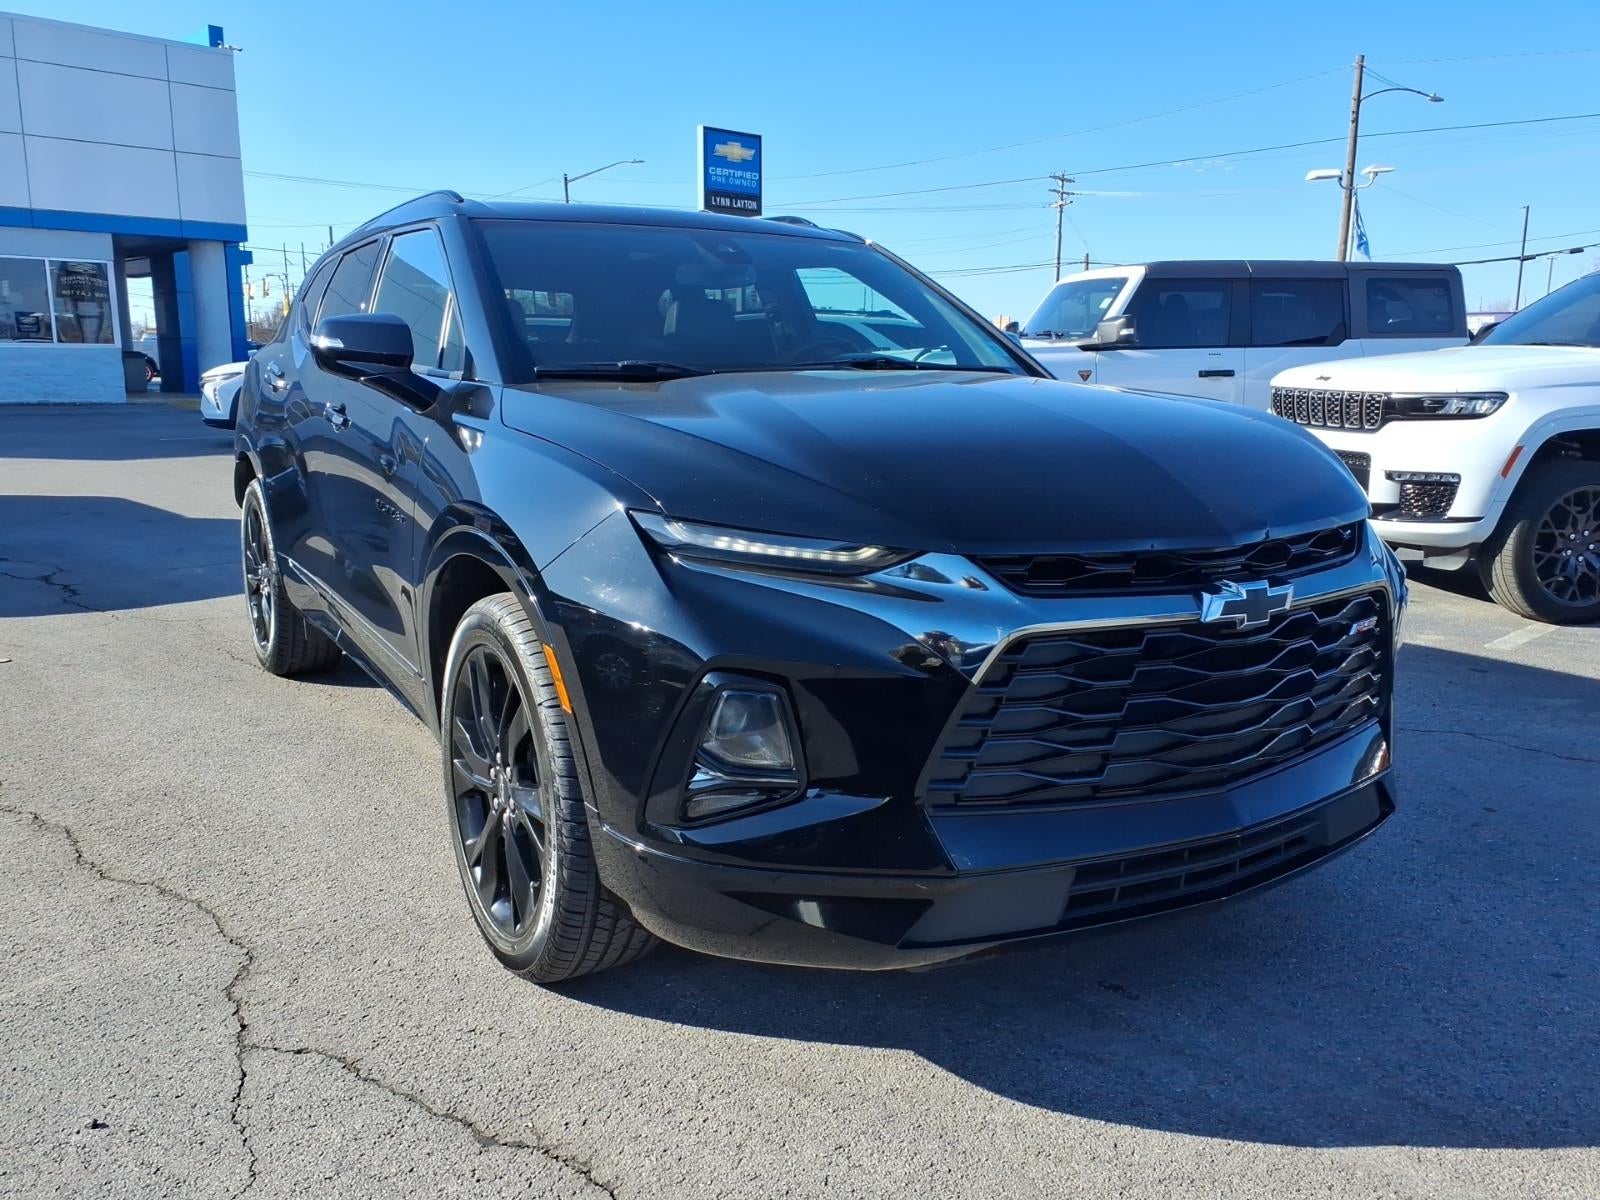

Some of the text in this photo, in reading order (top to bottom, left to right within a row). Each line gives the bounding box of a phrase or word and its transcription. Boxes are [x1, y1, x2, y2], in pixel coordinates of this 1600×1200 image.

[709, 167, 759, 180] CERTIFIED
[711, 196, 757, 209] LYNN LAYTON
